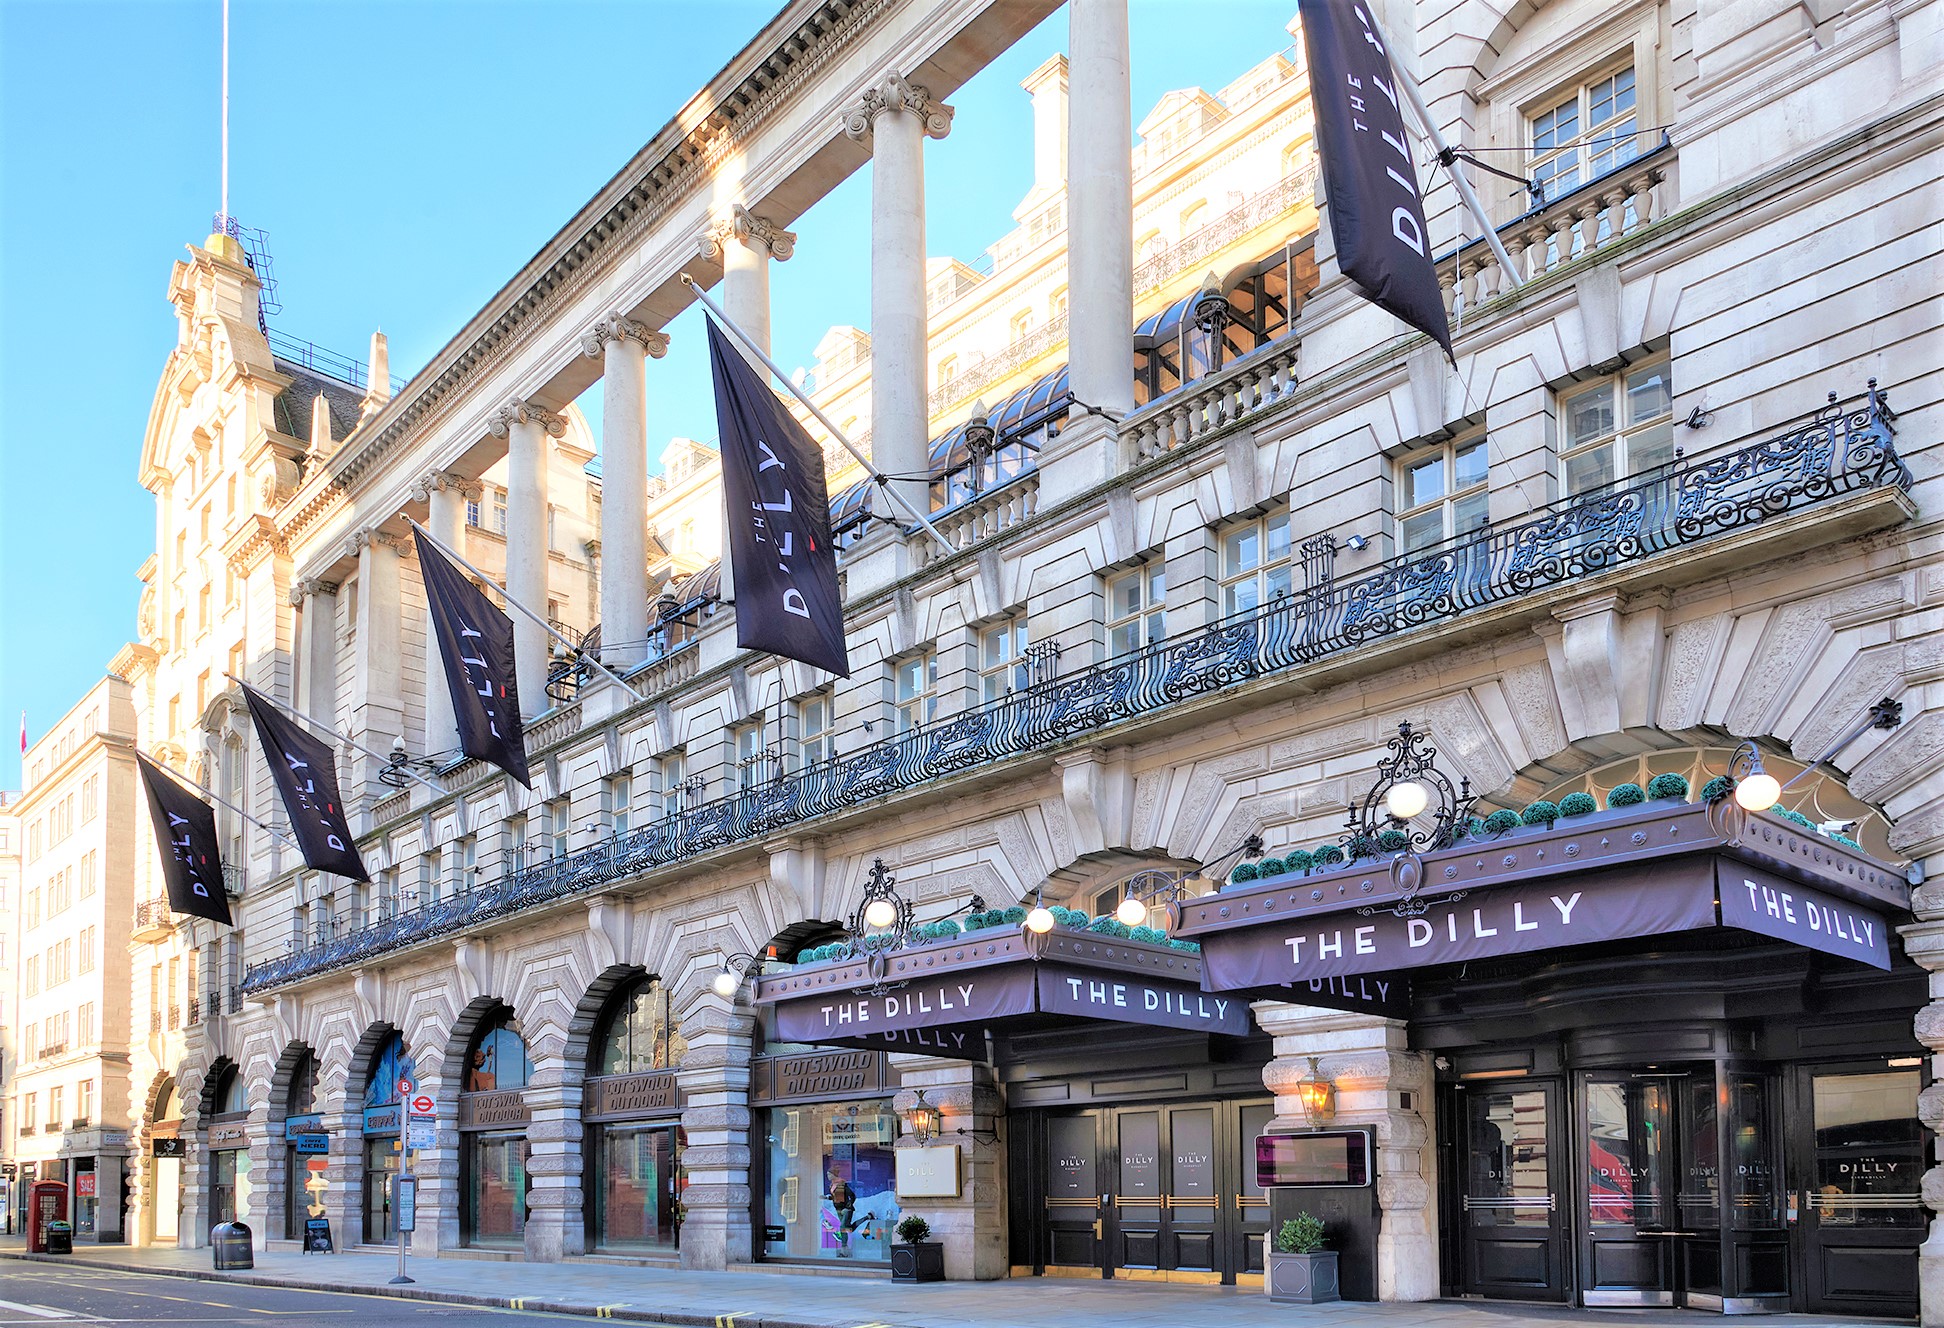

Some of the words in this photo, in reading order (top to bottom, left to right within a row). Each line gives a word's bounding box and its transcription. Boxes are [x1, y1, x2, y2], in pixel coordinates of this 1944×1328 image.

[1347, 73, 1368, 132] THE
[751, 499, 765, 543] THE
[461, 656, 475, 685] TH
[285, 752, 345, 852] DILY
[172, 840, 182, 861] THE
[1744, 879, 1797, 925] THE
[1805, 900, 1875, 948] DILLY
[1284, 925, 1376, 964] THE
[1407, 891, 1583, 948] DILLY
[1066, 977, 1127, 1008] THE
[1144, 990, 1228, 1020] DILLY
[1308, 975, 1389, 1003] DILLY
[821, 1005, 869, 1026] THE
[885, 983, 975, 1018] DILLY
[883, 1028, 965, 1049] DILLY
[782, 1052, 872, 1076] COTSWOLD
[402, 1082, 410, 1092] B
[606, 1074, 672, 1095] COTSWOLD
[787, 1072, 865, 1094] OUTDOOR
[610, 1093, 667, 1110] OUTDOOR
[479, 1108, 524, 1123] OUTDOOR
[1125, 1156, 1153, 1164] DILLY
[1177, 1155, 1208, 1164] DILLY
[1839, 1163, 1898, 1173] DILLY
[1600, 1168, 1649, 1177] DILLY
[80, 1179, 94, 1192] SALE
